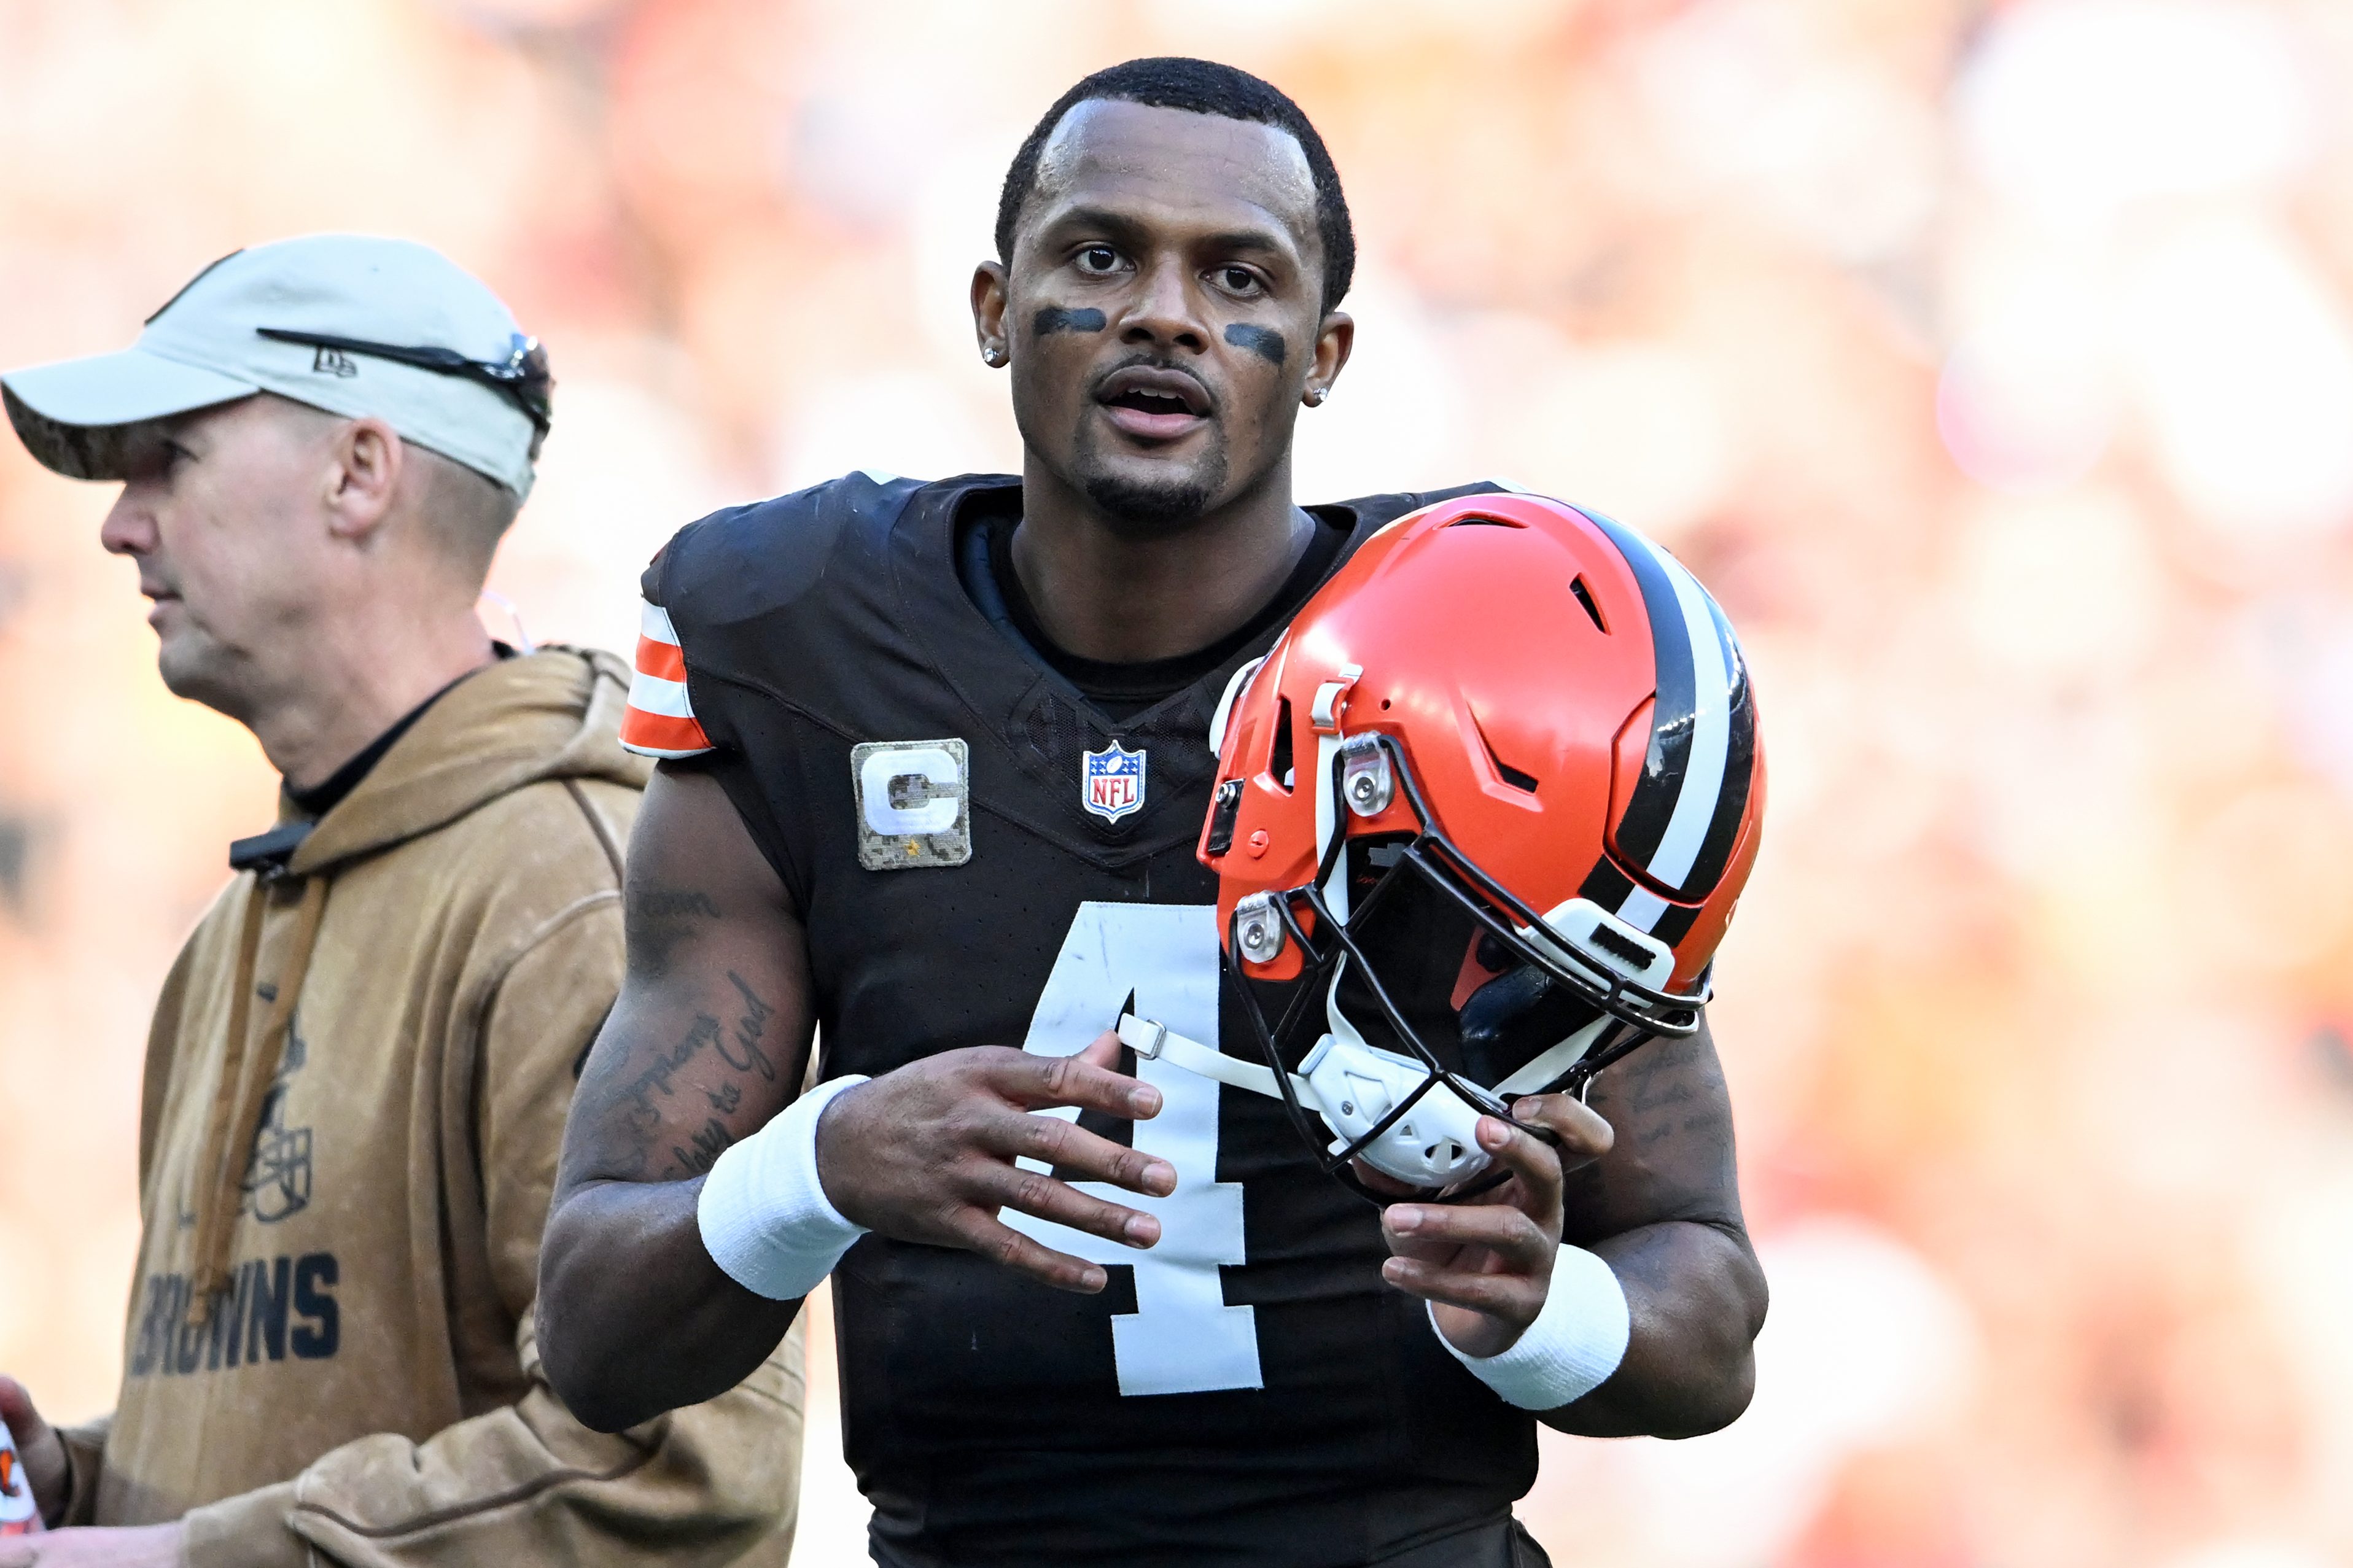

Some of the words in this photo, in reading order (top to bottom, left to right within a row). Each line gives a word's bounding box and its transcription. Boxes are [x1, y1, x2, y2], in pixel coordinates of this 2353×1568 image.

[861, 748, 959, 836] C
[1093, 777, 1135, 808] NFL
[998, 901, 1264, 1397] 4
